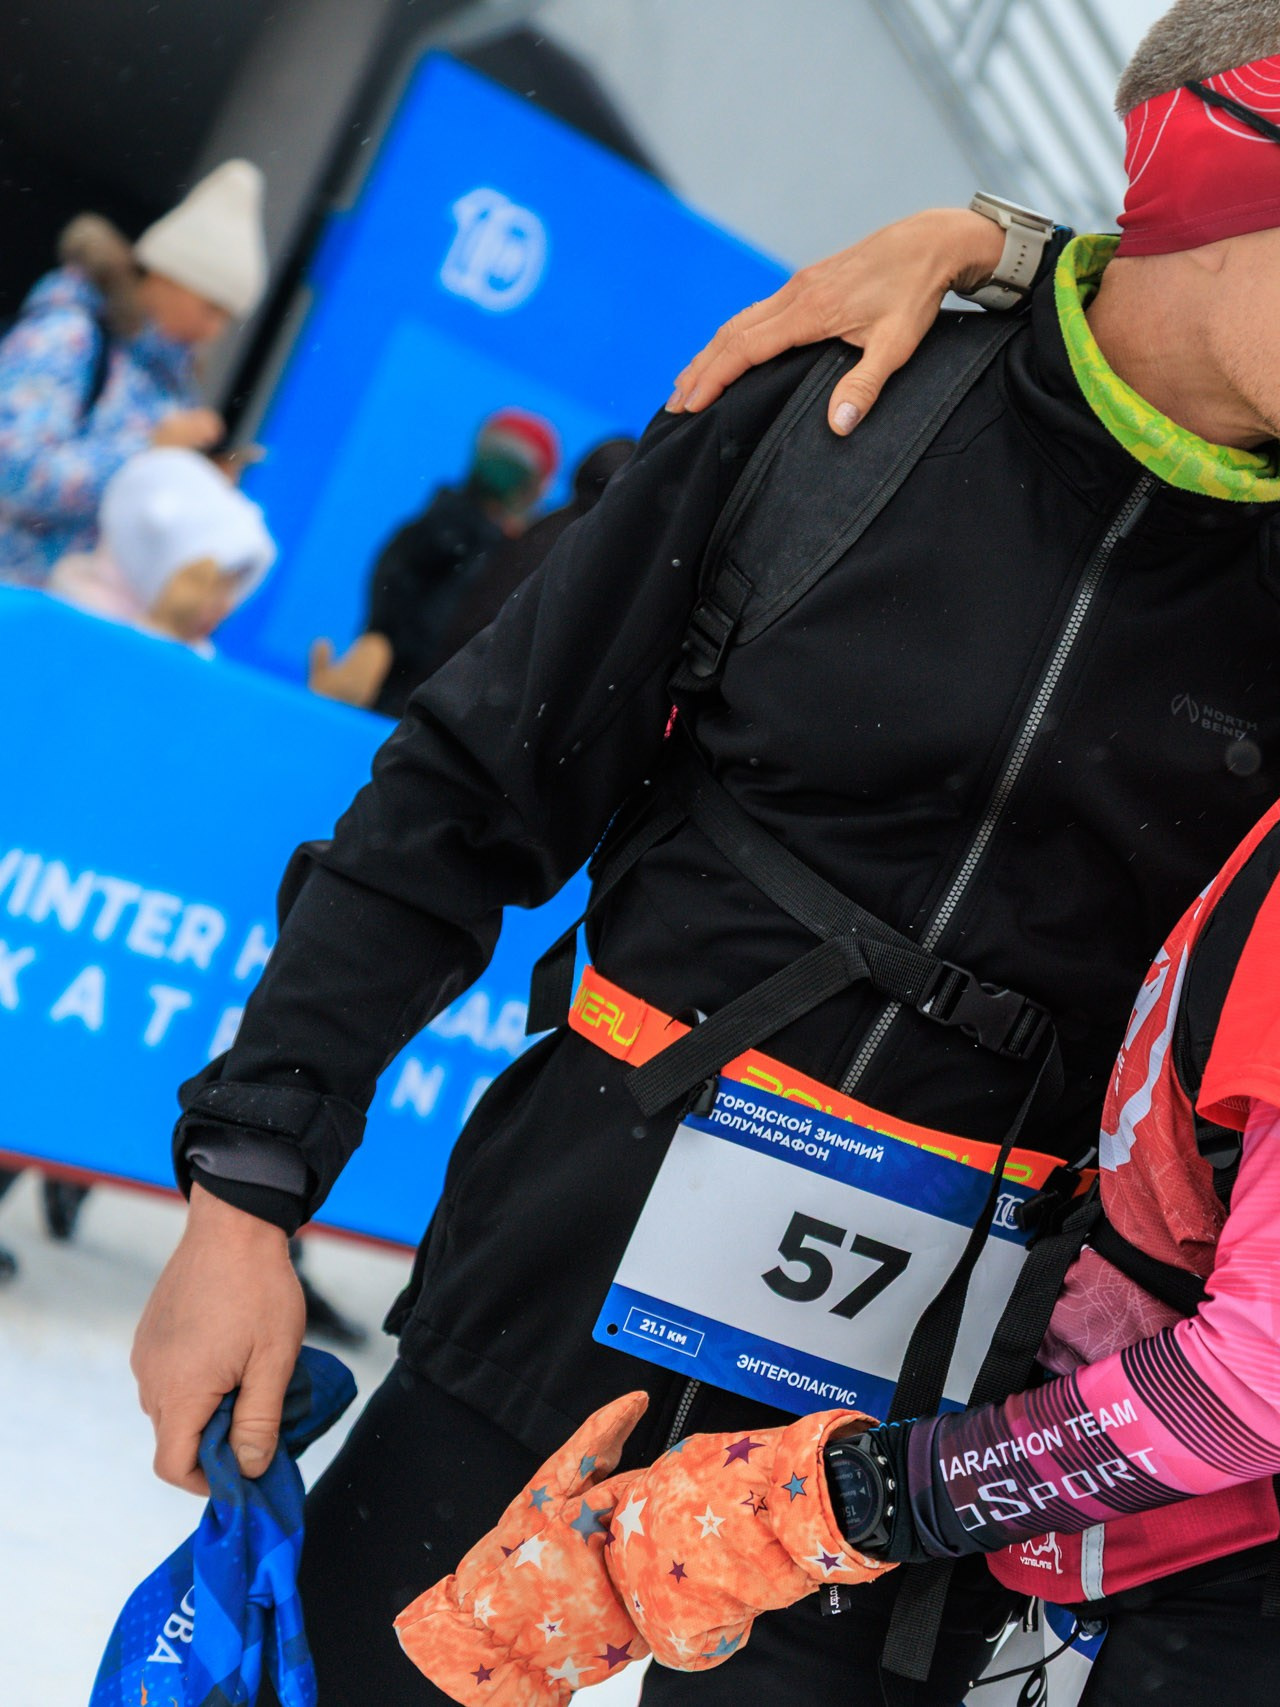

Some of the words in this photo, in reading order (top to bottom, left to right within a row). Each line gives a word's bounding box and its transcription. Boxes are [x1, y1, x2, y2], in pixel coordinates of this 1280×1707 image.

[1201, 718, 1245, 739] BEND
[1203, 705, 1257, 731] NORTH
[709, 1109, 830, 1162] ПОЛУМАРАФОН
[715, 1092, 813, 1136] ГОРОДСКОЙ
[814, 1127, 885, 1163] ЗИМНИЙ
[761, 1211, 912, 1320] 57
[639, 1318, 665, 1338] 21.1
[736, 1354, 857, 1406] ЭНТЕРОЛАКТИС
[1064, 1398, 1138, 1442] TEAM
